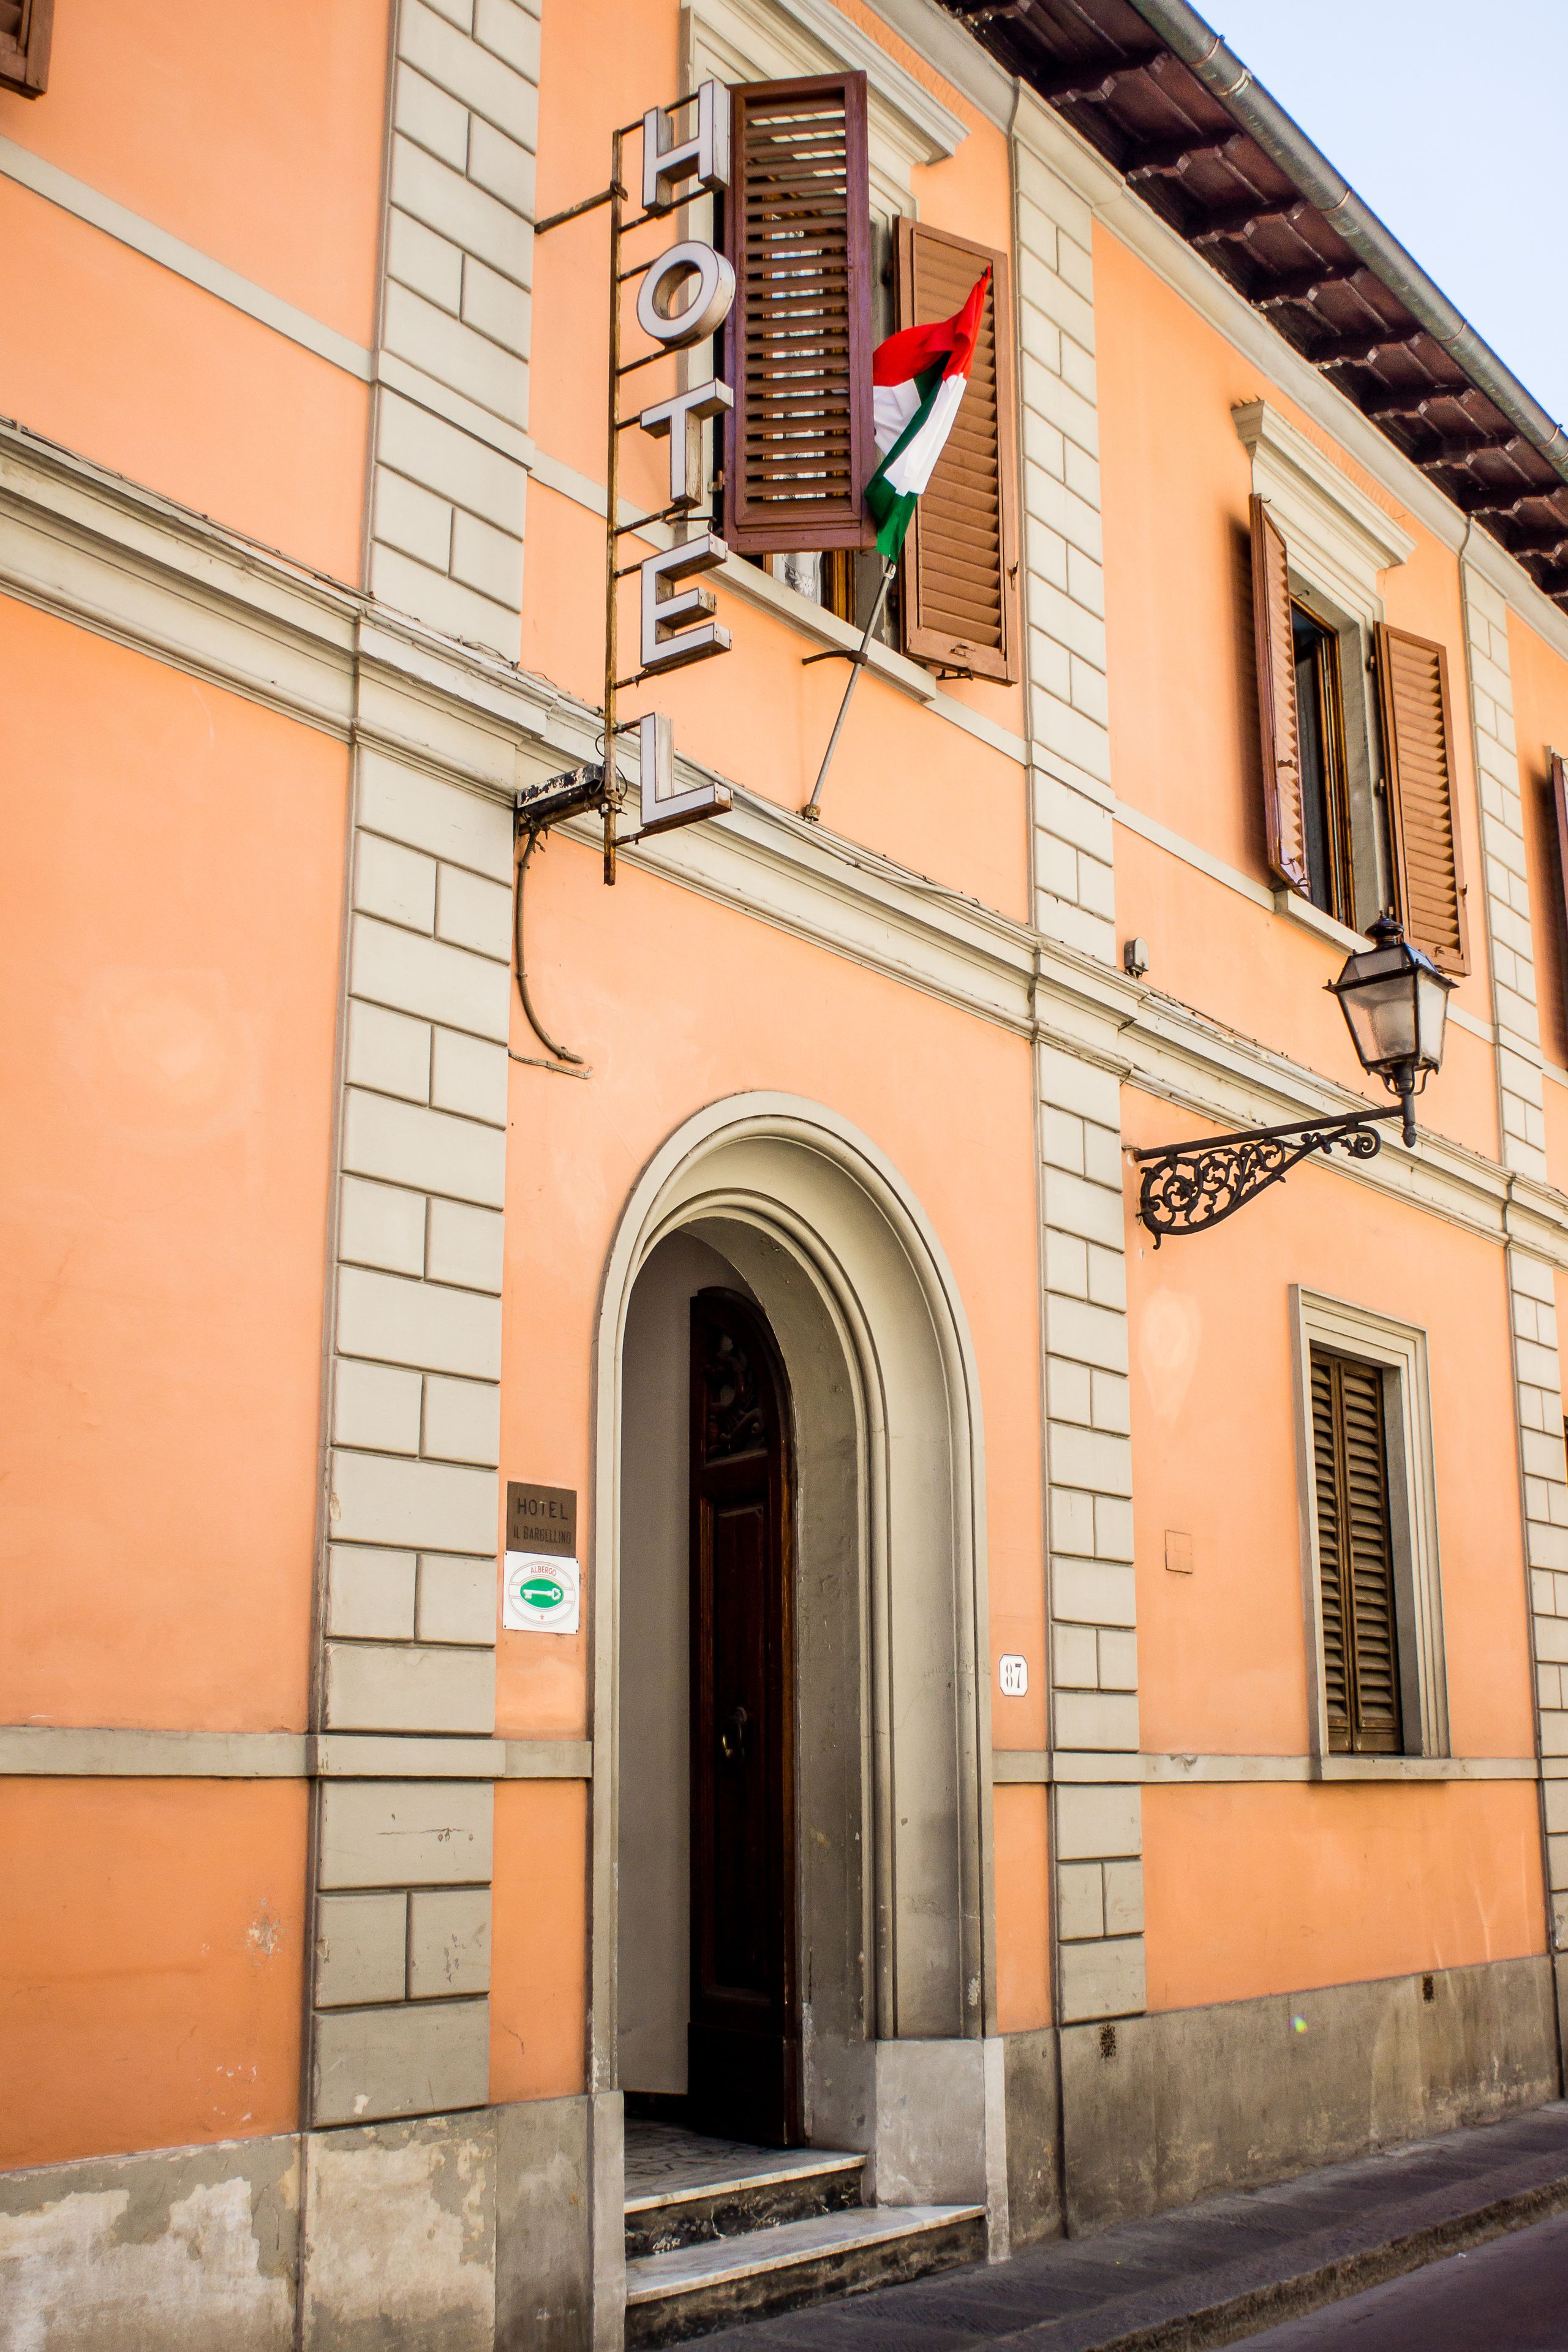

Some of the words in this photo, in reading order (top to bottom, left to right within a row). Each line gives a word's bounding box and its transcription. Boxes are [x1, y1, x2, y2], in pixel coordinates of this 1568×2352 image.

[638, 80, 735, 831] HOTEL
[517, 1498, 568, 1520] HOTEL
[513, 1525, 520, 1539] IL
[524, 1526, 571, 1544] BARGELLINO
[530, 1566, 557, 1577] ALBERGO
[1006, 1662, 1022, 1689] 87
